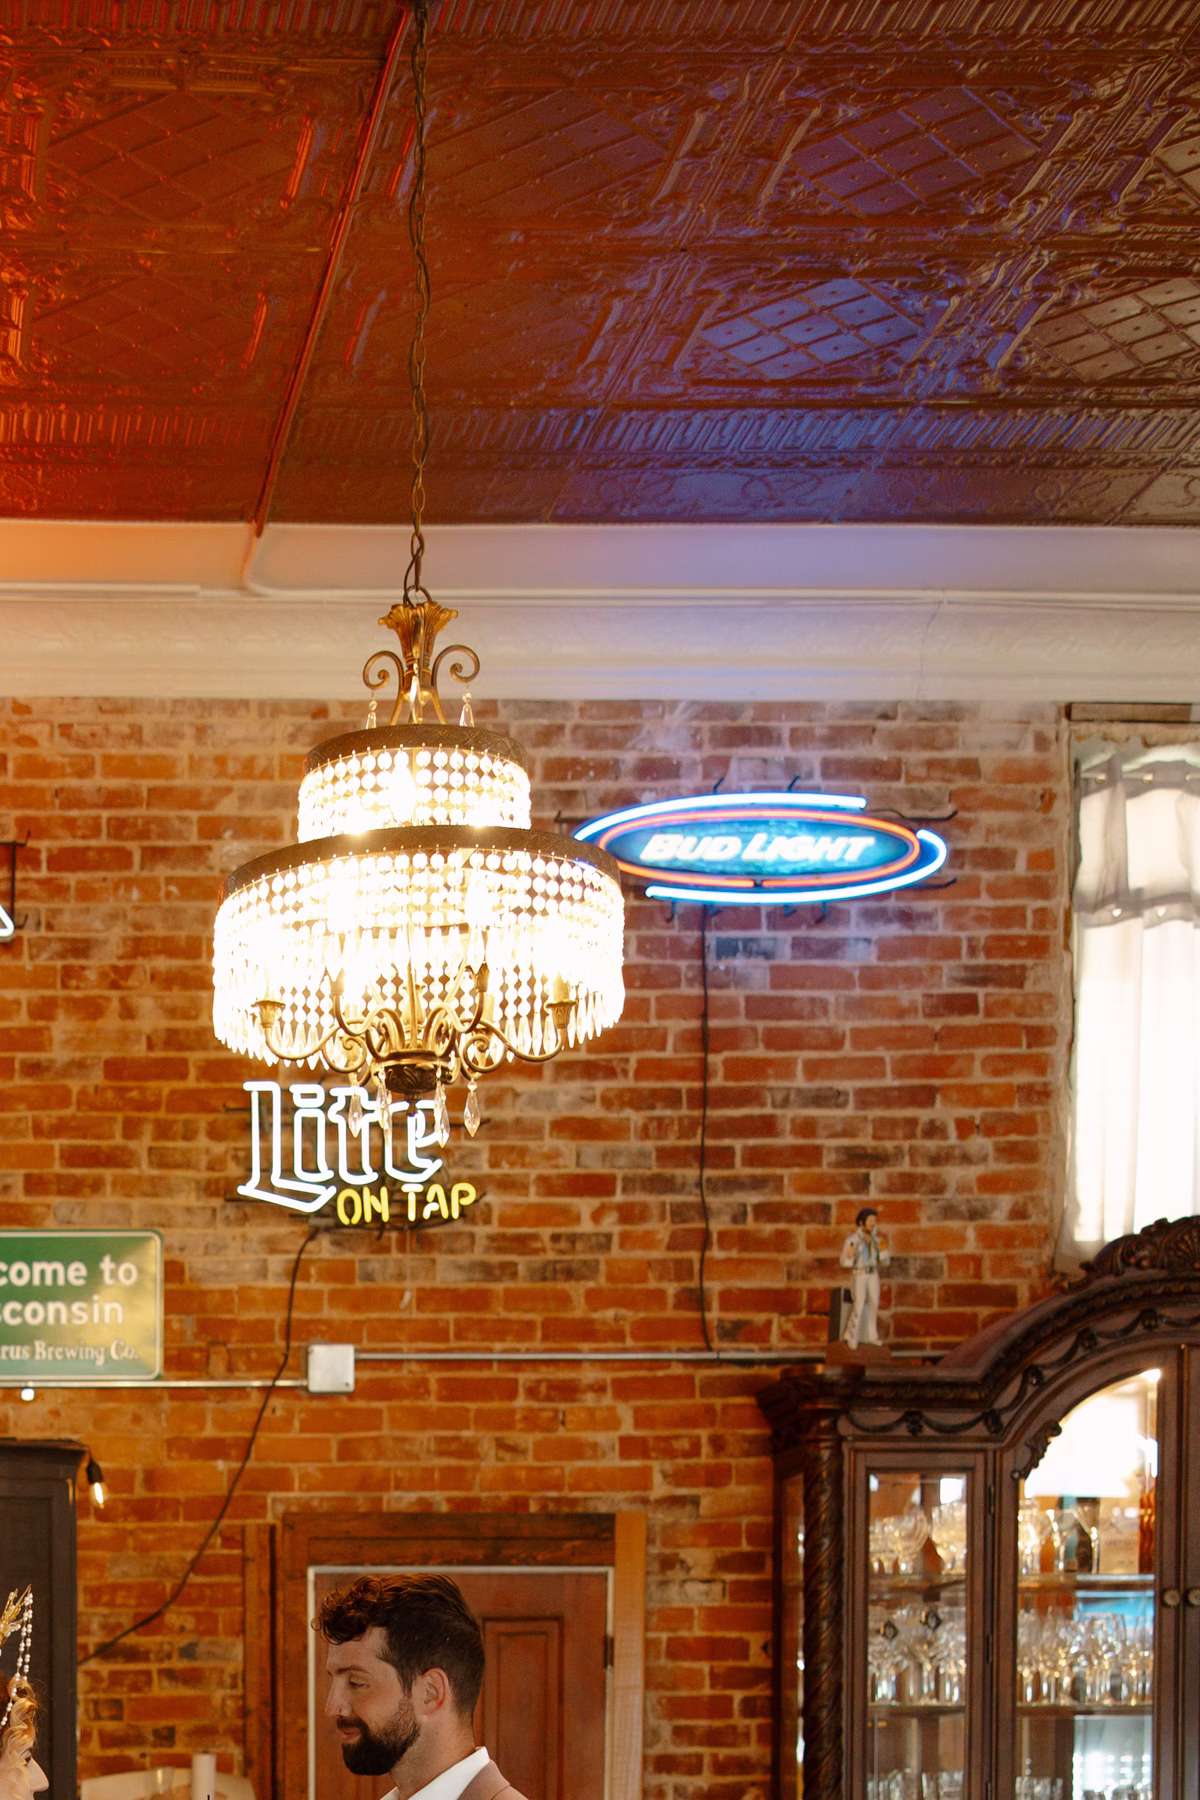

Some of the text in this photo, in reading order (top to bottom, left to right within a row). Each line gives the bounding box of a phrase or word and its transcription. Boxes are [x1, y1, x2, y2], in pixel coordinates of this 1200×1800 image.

[640, 832, 876, 863] BUD LIGHT
[236, 1080, 446, 1214] Lite
[336, 1182, 477, 1226] ON TAP
[99, 1253, 139, 1286] to
[34, 1339, 105, 1367] Brewing
[110, 1339, 139, 1361] Co.
